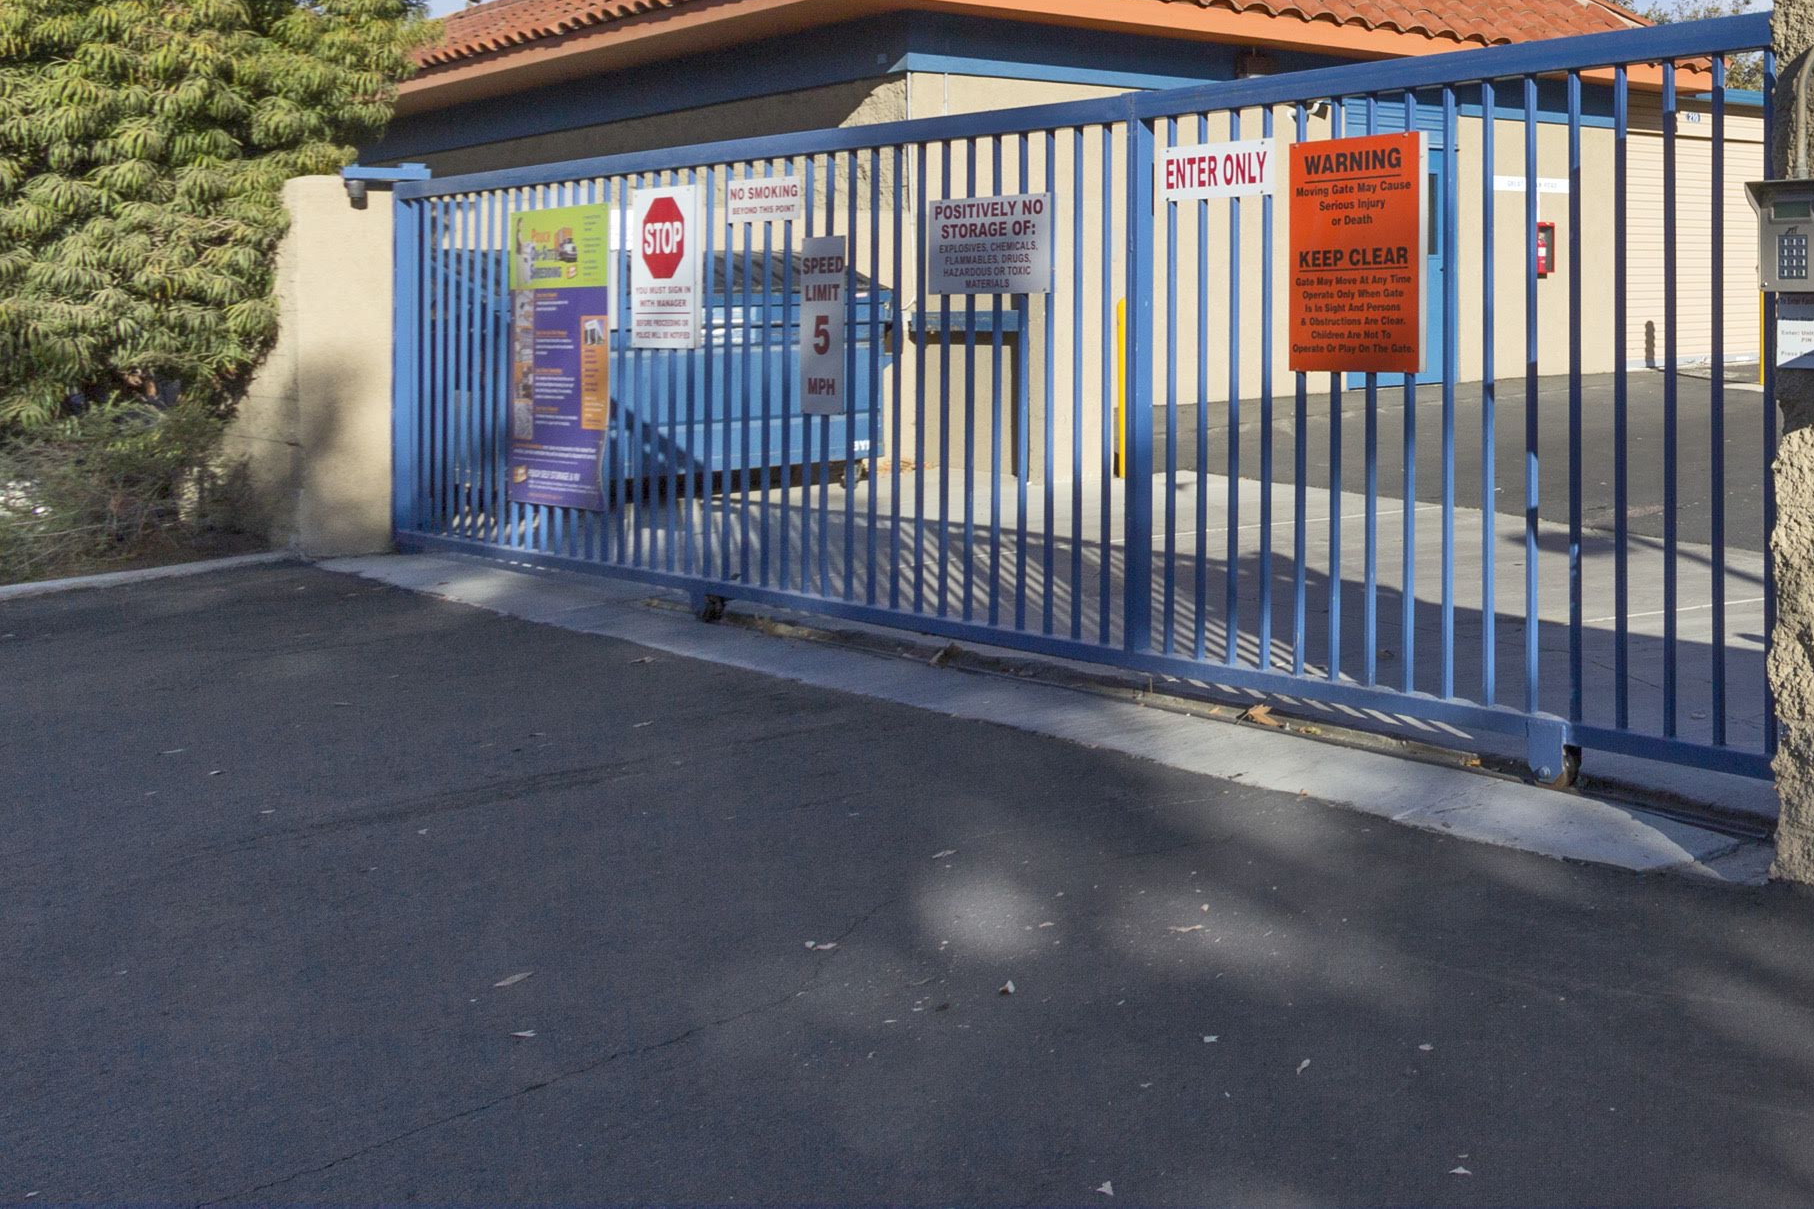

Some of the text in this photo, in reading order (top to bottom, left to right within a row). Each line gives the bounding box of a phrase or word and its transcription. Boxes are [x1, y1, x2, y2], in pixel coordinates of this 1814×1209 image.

[1304, 147, 1402, 175] WARNING
[1166, 151, 1267, 189] ENTER ONLY
[730, 184, 798, 200] NO SMOKING
[1296, 180, 1411, 197] Moving Gate May Cause
[732, 204, 796, 215] BEYOND THIS POINT
[935, 198, 1043, 220] POSITIVELY NO
[1319, 198, 1385, 211] Serious Injury
[1331, 214, 1373, 226] or Death
[941, 219, 1035, 239] STORAGE OF:
[644, 221, 683, 255] STOP
[939, 241, 1038, 253] EXPLOSIVES, CHEMICALS,
[945, 253, 1031, 265] FLAMMABLES, DRUGS,
[1299, 246, 1409, 268] KEEP CLEAR
[803, 256, 844, 274] SPEED
[943, 265, 1031, 277] HAZARDOUS OR TOXIC
[965, 278, 1010, 288] MATERIALS
[1296, 274, 1411, 287] Gate May Move At Any Time
[636, 285, 691, 294] YOU MUST SIGN IN
[805, 284, 840, 301] LIMIT
[1302, 288, 1404, 301] Operate Only When Gate
[640, 299, 687, 307] WITH MANAGER
[1305, 302, 1401, 314] Is In Sight And Persons
[636, 319, 689, 327] BEFORE PROCEEDING OR
[1301, 316, 1406, 326] & Obstructions Are Clear.
[670, 331, 690, 339] NOTIFIED
[813, 315, 830, 355] 5
[1311, 330, 1391, 339] Children Are Not To
[1293, 344, 1415, 354] Operate Or Play On The Gate.
[808, 378, 836, 395] MPH
